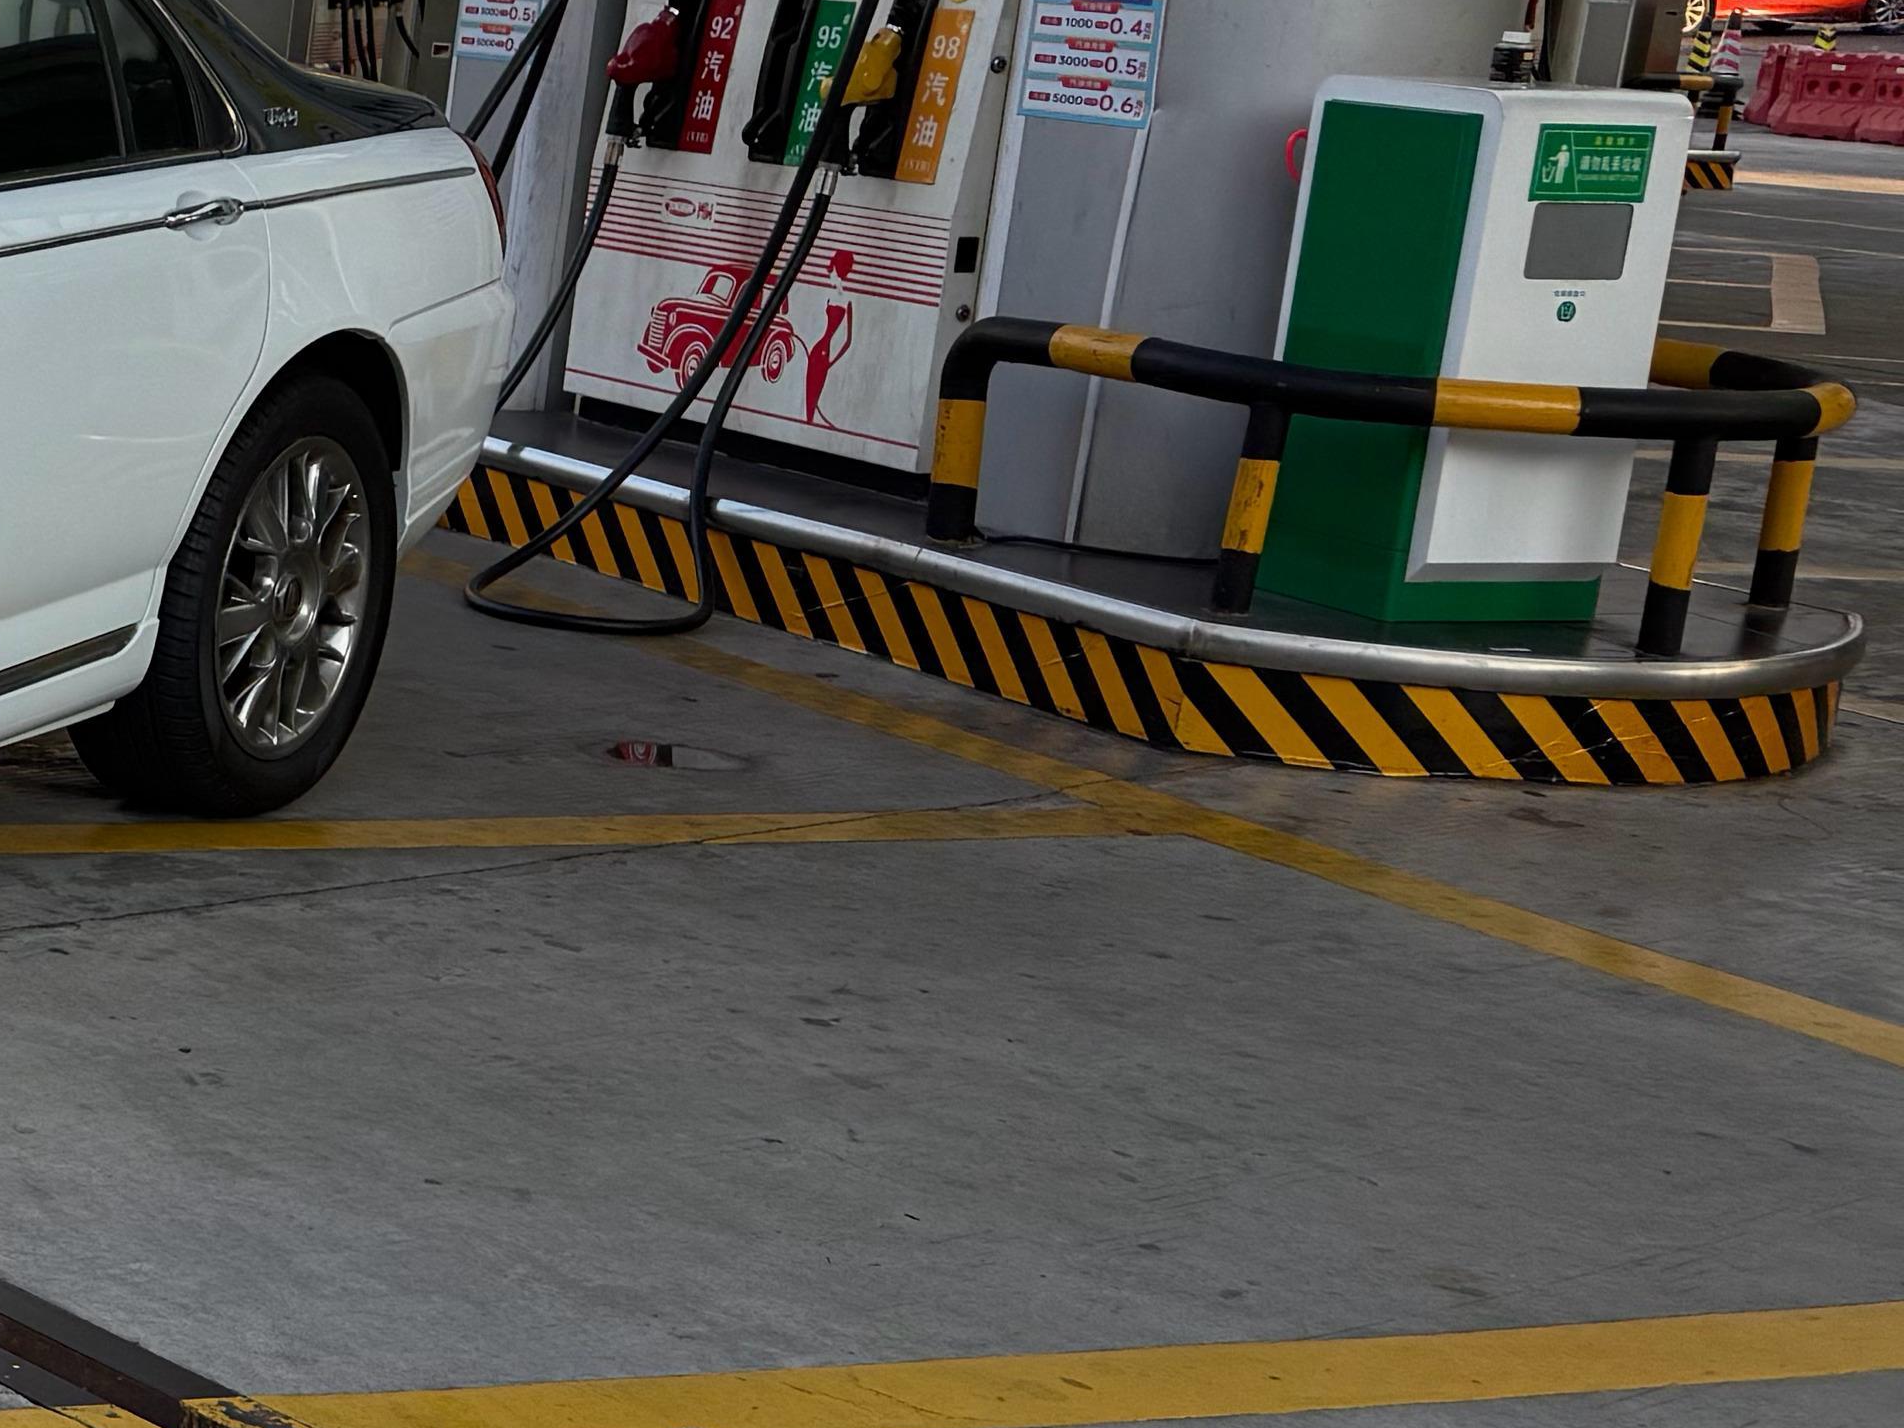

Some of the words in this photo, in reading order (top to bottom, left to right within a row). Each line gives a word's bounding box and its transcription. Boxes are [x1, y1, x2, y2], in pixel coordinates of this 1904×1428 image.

[709, 16, 734, 39] 92
[816, 25, 842, 48] 95
[1065, 17, 1093, 28] 1000
[1110, 18, 1143, 36] 0.4
[932, 35, 961, 60] 98
[1058, 55, 1089, 67] 3000
[1104, 56, 1138, 75] 0.5
[692, 50, 725, 120] 汽油
[798, 61, 833, 132] 汽油
[912, 72, 950, 149] 汽油
[1052, 94, 1083, 105] 5000
[1099, 95, 1134, 113] 0.6
